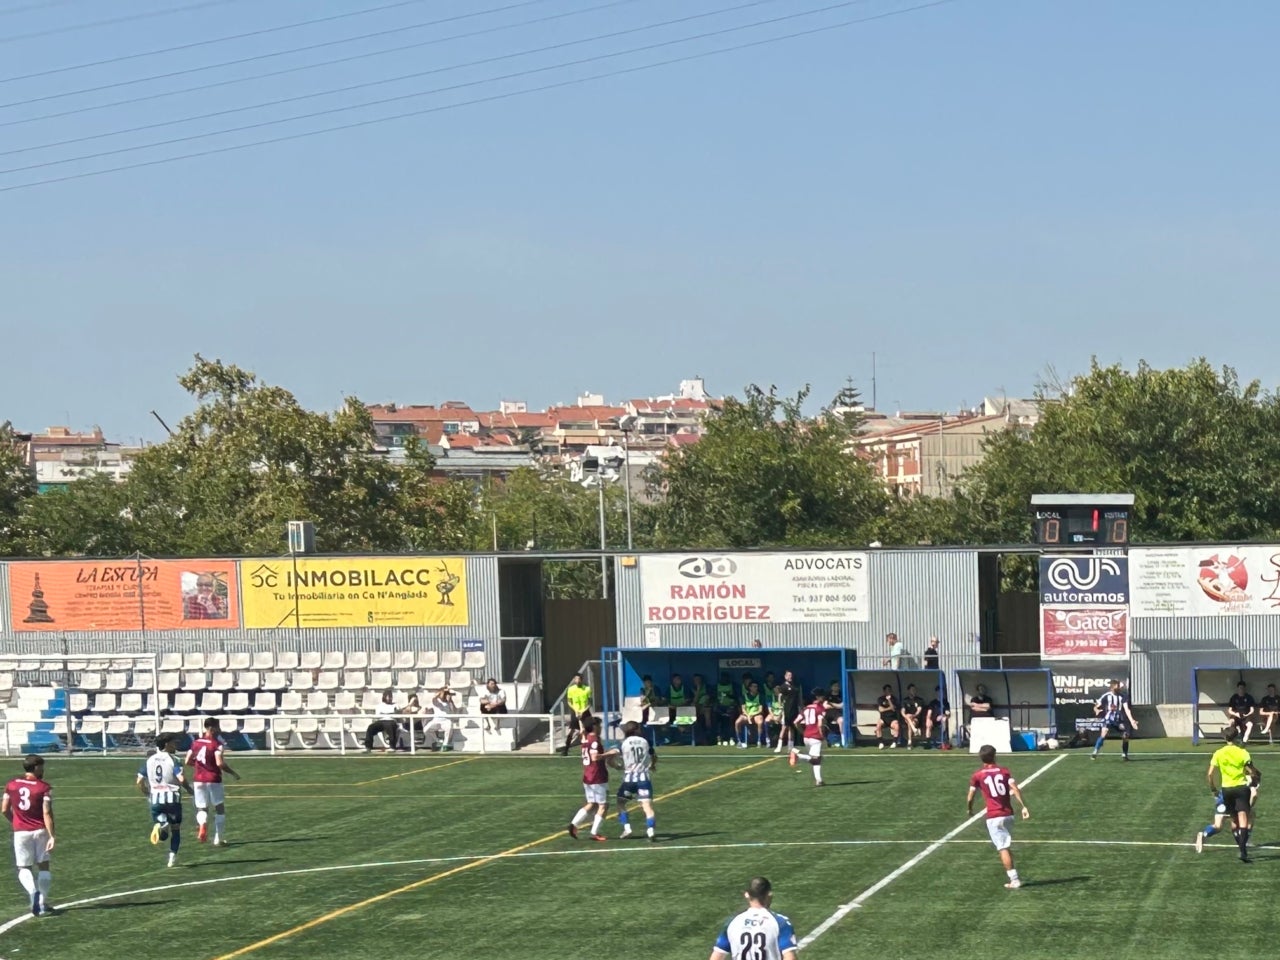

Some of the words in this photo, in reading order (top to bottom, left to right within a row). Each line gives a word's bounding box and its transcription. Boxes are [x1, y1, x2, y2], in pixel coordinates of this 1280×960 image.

[1036, 511, 1061, 519] LOCAL
[784, 558, 862, 570] ADVOCATS
[76, 567, 98, 583] LA
[287, 569, 431, 587] INMOBILACC
[273, 592, 285, 600] Tu
[670, 581, 746, 599] RAMÓN
[1044, 591, 1125, 602] autoramos
[648, 602, 771, 621] RODRÍGUEZ
[726, 659, 755, 667] LOCAL
[156, 765, 162, 783] 9
[984, 774, 1006, 797] 16
[18, 787, 31, 811] 3
